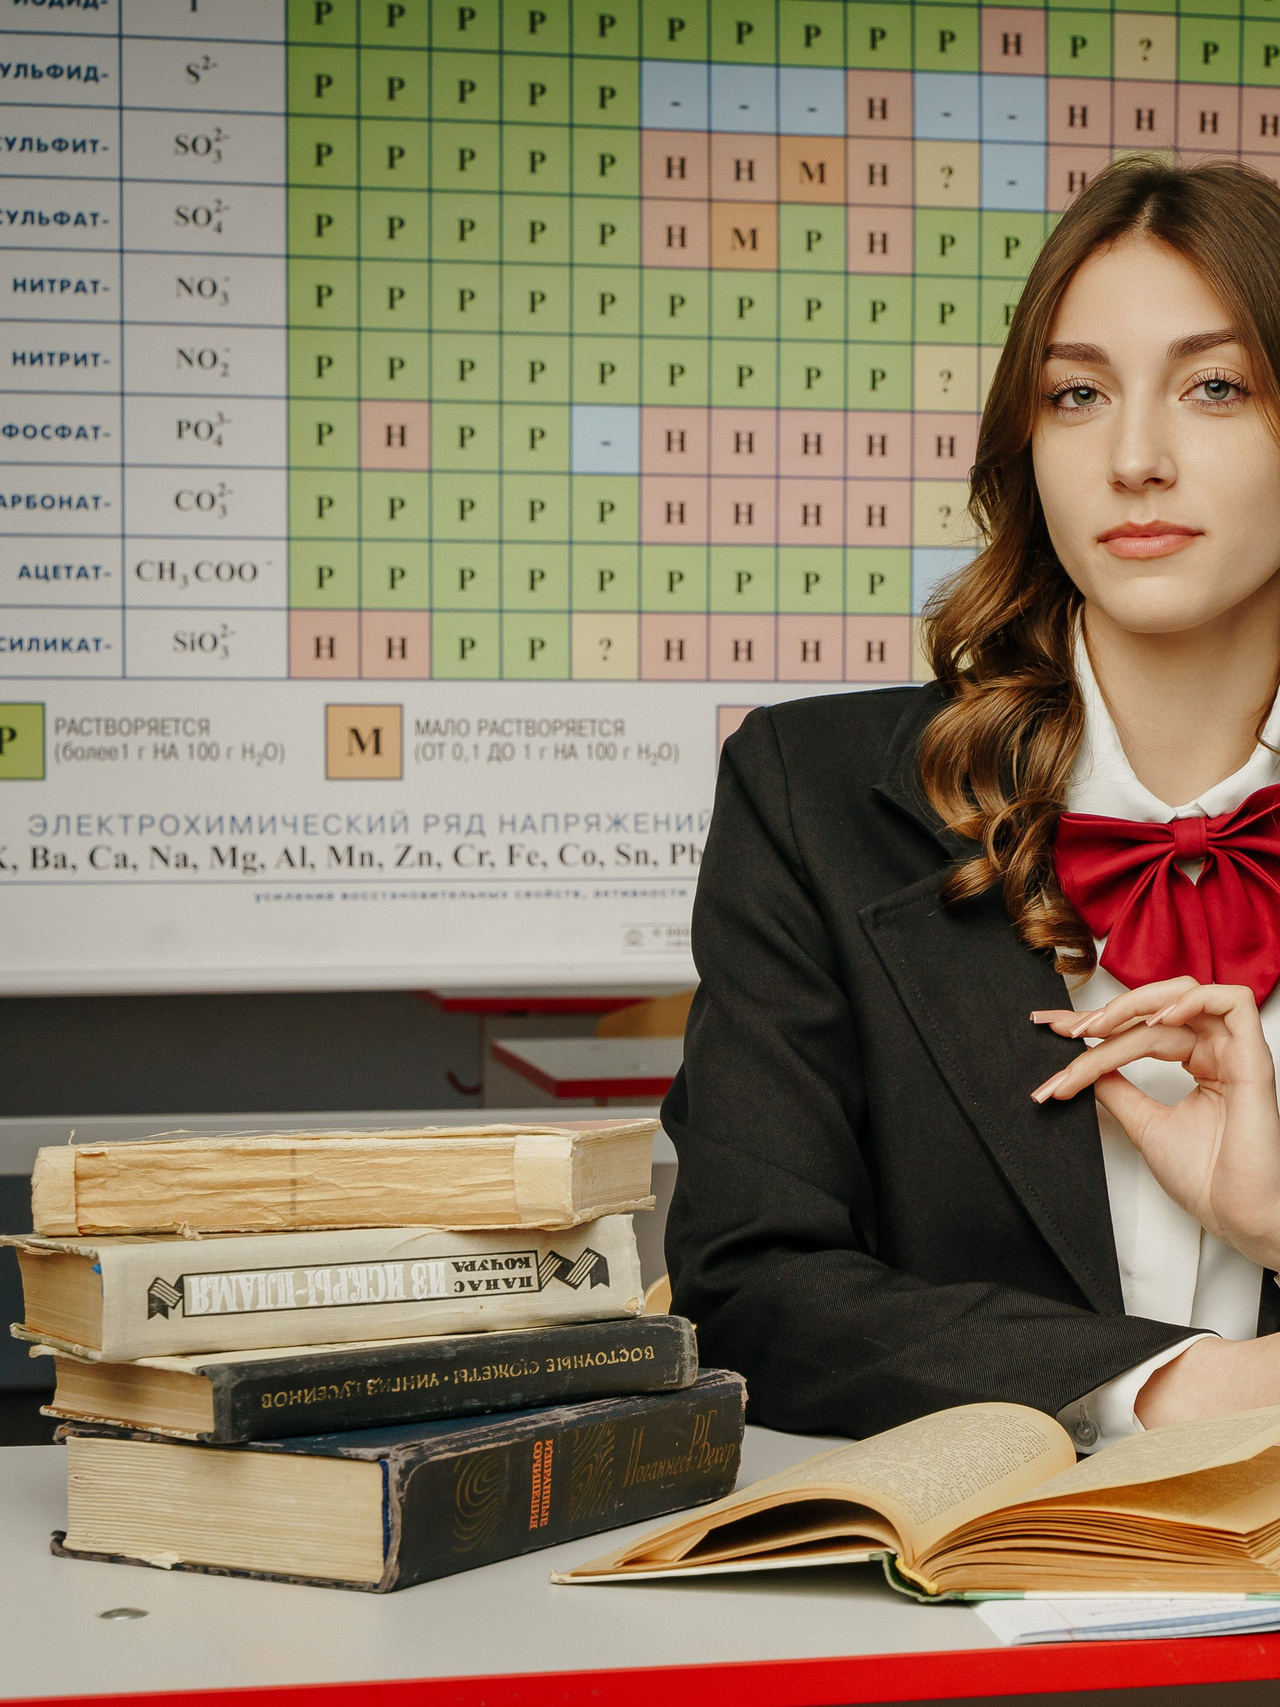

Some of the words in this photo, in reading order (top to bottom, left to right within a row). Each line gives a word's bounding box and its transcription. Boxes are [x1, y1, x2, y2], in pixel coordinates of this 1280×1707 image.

[667, 16, 686, 42] Р
[869, 26, 888, 51] Р
[1001, 32, 1022, 56] Н
[1070, 34, 1088, 59] Р
[1202, 40, 1220, 66] Р
[314, 73, 334, 99] Р
[528, 81, 548, 107] Р
[867, 97, 888, 121] Н
[1135, 107, 1155, 132] Н
[666, 155, 687, 180] Н
[800, 160, 826, 184] М
[315, 213, 334, 238] Р
[732, 227, 758, 251] М
[1004, 236, 1021, 260] Р
[12, 277, 110, 295] НИТРАТ-
[388, 286, 406, 311] Р
[599, 292, 617, 316] Р
[939, 302, 956, 325] Р
[12, 350, 111, 368] НИТРИТ-
[316, 355, 334, 379] Р
[737, 365, 754, 389] Р
[386, 424, 406, 448] Н
[867, 434, 887, 457] Н
[459, 498, 476, 522] Р
[734, 502, 754, 526] Н
[18, 564, 113, 582] АЦЕТАТ-
[317, 566, 335, 590] Р
[598, 569, 616, 593] Р
[869, 572, 886, 596] Р
[314, 636, 335, 659] Н
[529, 638, 546, 661] Р
[801, 640, 821, 663] Н
[53, 716, 211, 738] РАСТВОРЯЕТСЯ
[346, 726, 383, 758] М
[414, 718, 472, 739] МАЛО
[476, 718, 626, 739] РАСТВОРЯЕТСЯ
[188, 743, 220, 762] 100
[587, 742, 618, 761] 100
[27, 810, 410, 838] ЭЛЕКТРОХИМИЧЕСКИЙ
[422, 812, 486, 838] РЯД
[410, 1260, 449, 1301] ИЗ
[453, 1256, 533, 1273] КОЧУРА
[188, 1263, 406, 1316] ИСКРЫ-ПЛАМЯ
[453, 1275, 534, 1293] ПАНАС
[545, 1344, 656, 1374] ВОСТОЧНЫЕ
[529, 1440, 544, 1531] СОЧИНЕНИЯ
[539, 1438, 554, 1528] ИЗБРАННЫЕ
